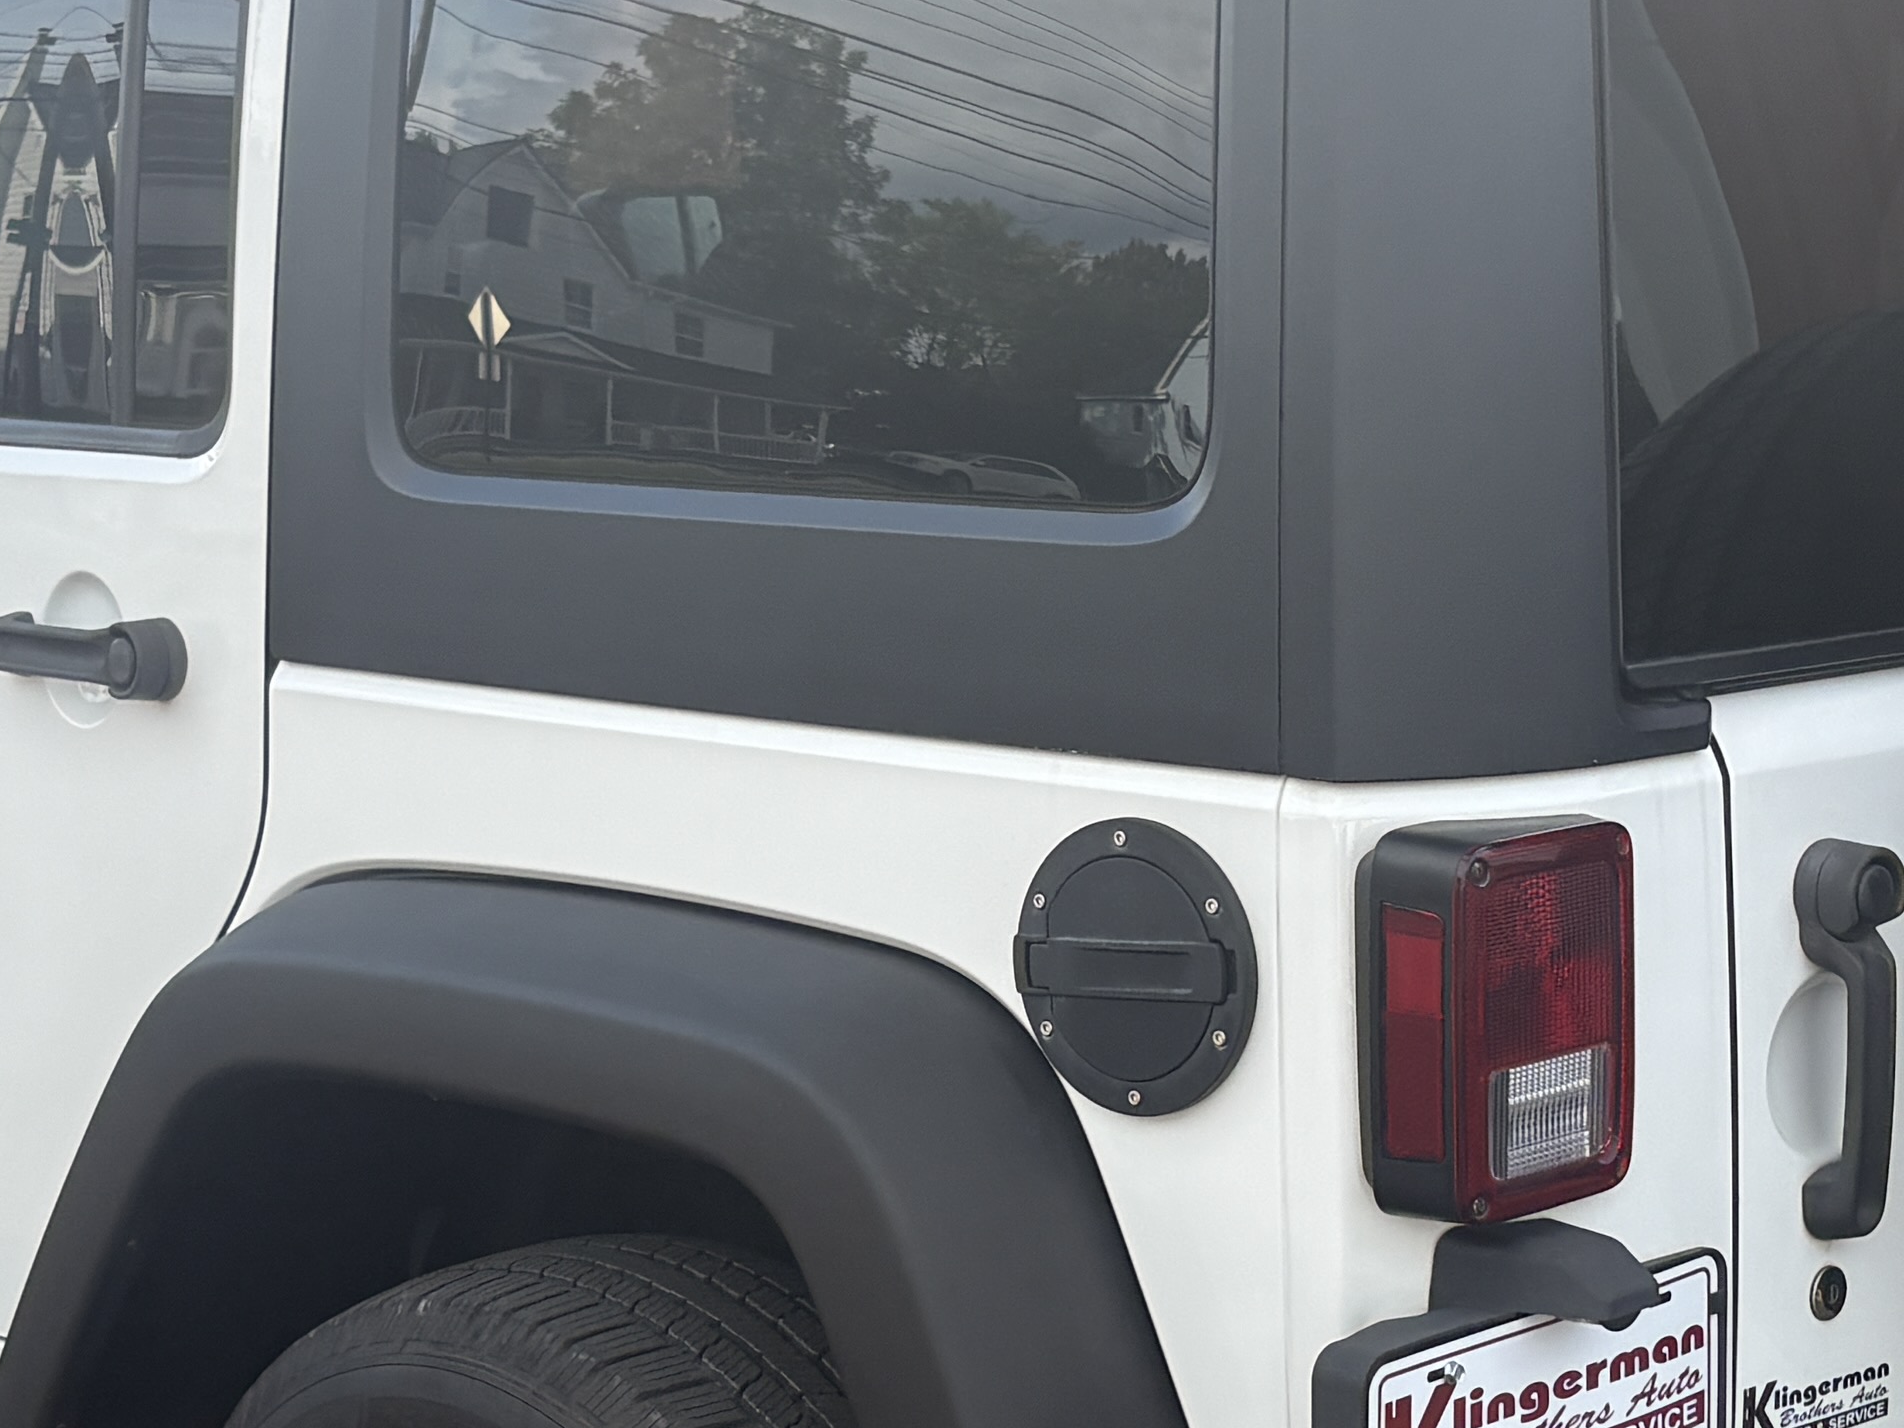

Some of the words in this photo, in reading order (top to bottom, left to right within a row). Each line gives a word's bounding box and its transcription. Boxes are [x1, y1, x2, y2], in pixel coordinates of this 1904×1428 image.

[1626, 1366, 1703, 1417] Auto
[1779, 1398, 1845, 1428] Brothers
[1850, 1384, 1889, 1408] Auto
